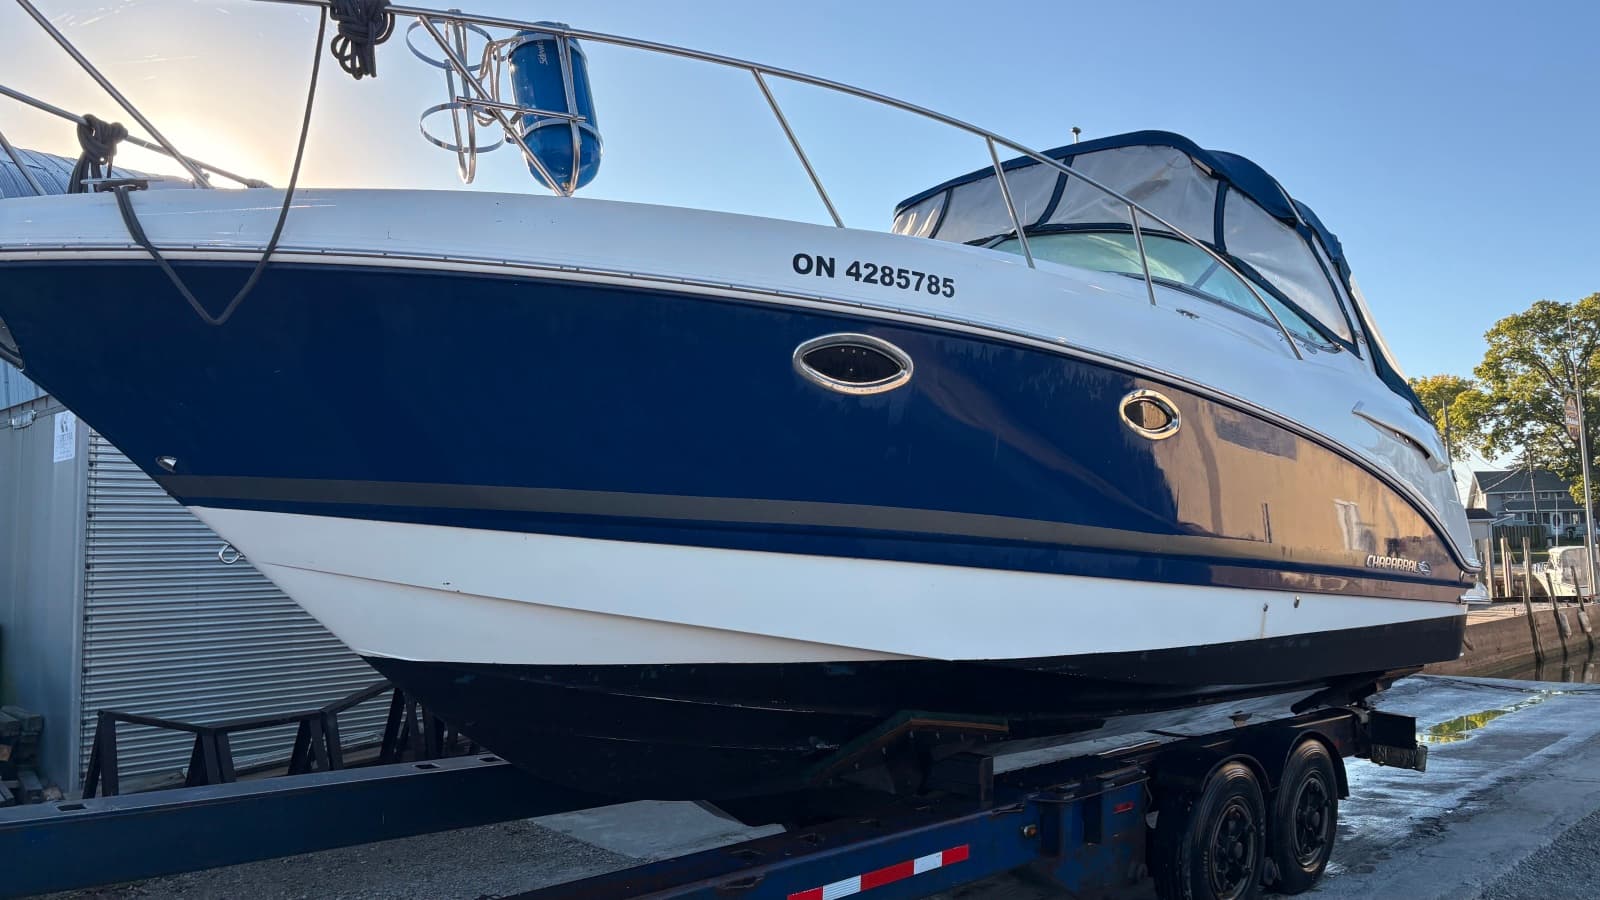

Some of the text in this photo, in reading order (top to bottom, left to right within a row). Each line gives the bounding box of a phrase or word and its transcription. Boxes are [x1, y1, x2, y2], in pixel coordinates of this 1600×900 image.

[792, 253, 955, 298] ON 4285785
[1366, 554, 1419, 573] CHAPARRAL
